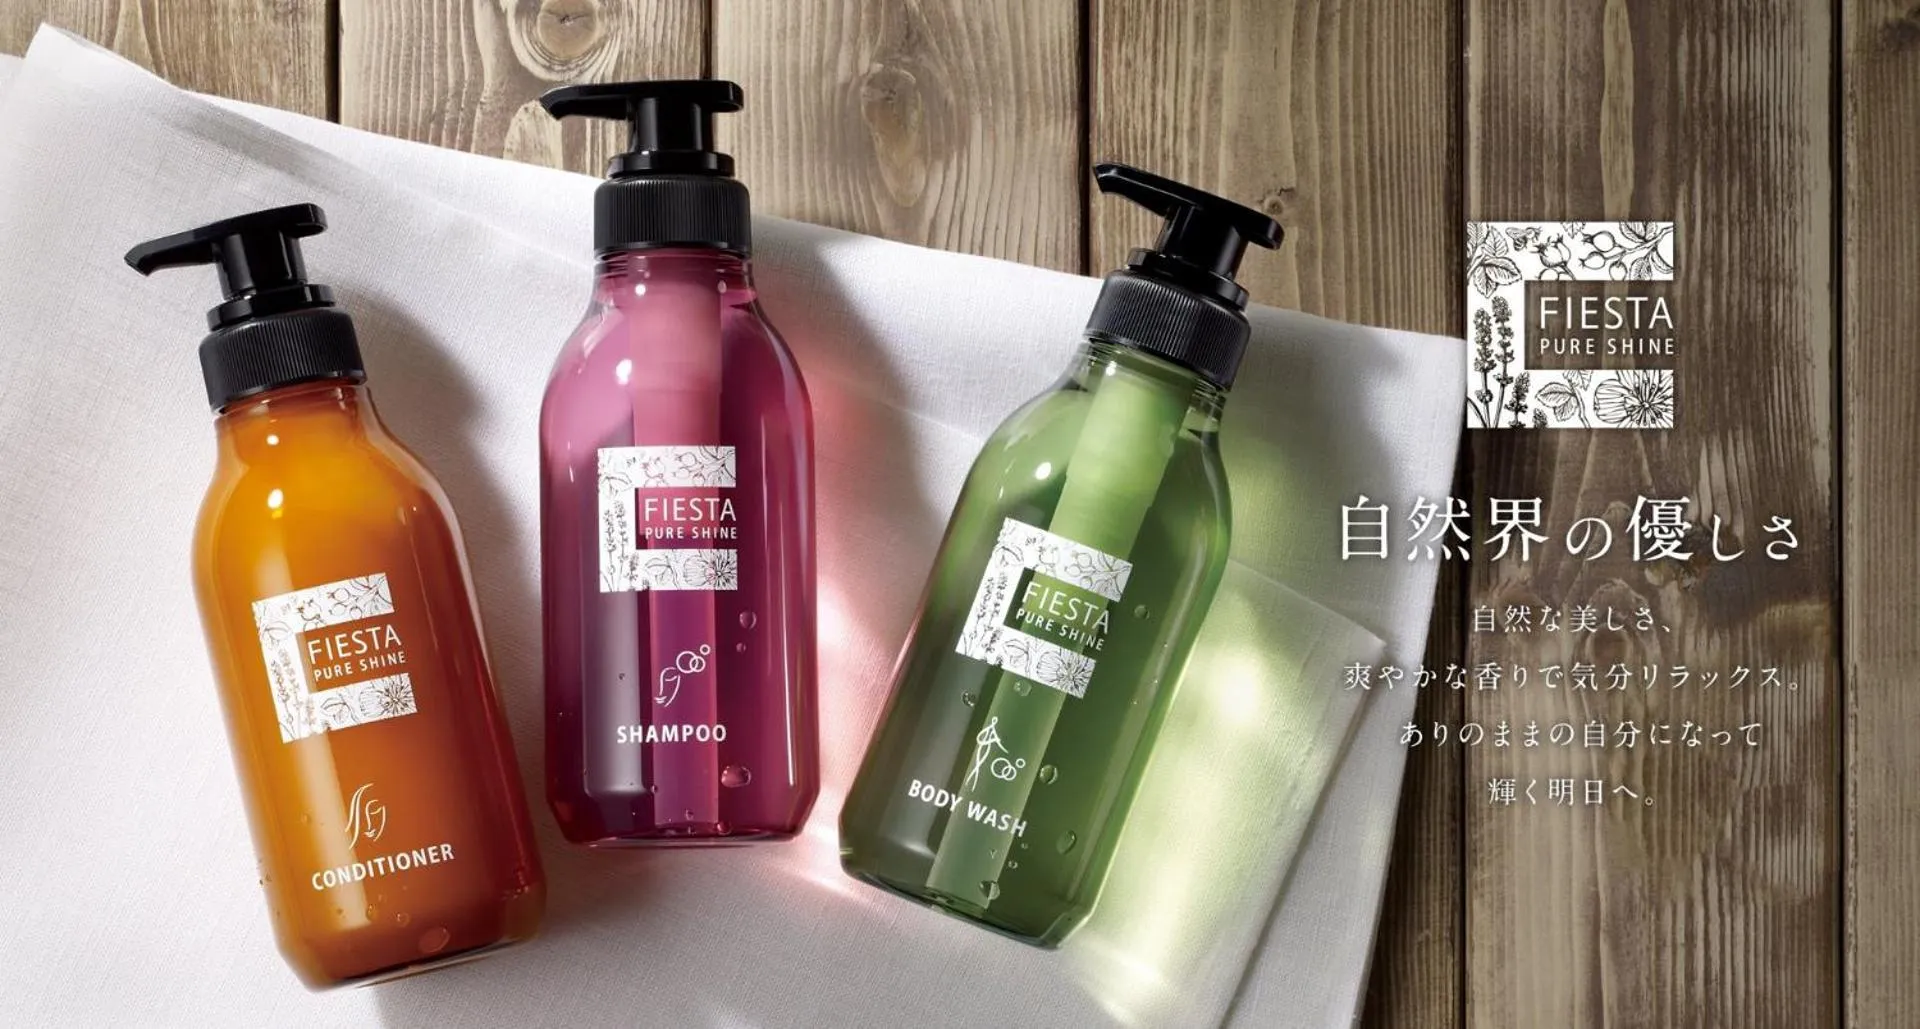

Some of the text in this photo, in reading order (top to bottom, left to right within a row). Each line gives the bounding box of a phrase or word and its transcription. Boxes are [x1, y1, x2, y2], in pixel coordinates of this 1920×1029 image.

[644, 497, 737, 522] FIESTA
[645, 526, 737, 540] PURE SHINE
[1022, 580, 1110, 634] FIESTA
[307, 624, 402, 665] FIESTA
[1015, 609, 1105, 650] PURE SHINE
[314, 651, 406, 682] PURE SHINE
[617, 724, 727, 744] SHAMPOO
[908, 779, 1027, 837] BODY WASH
[311, 843, 455, 891] CONDITIONER
